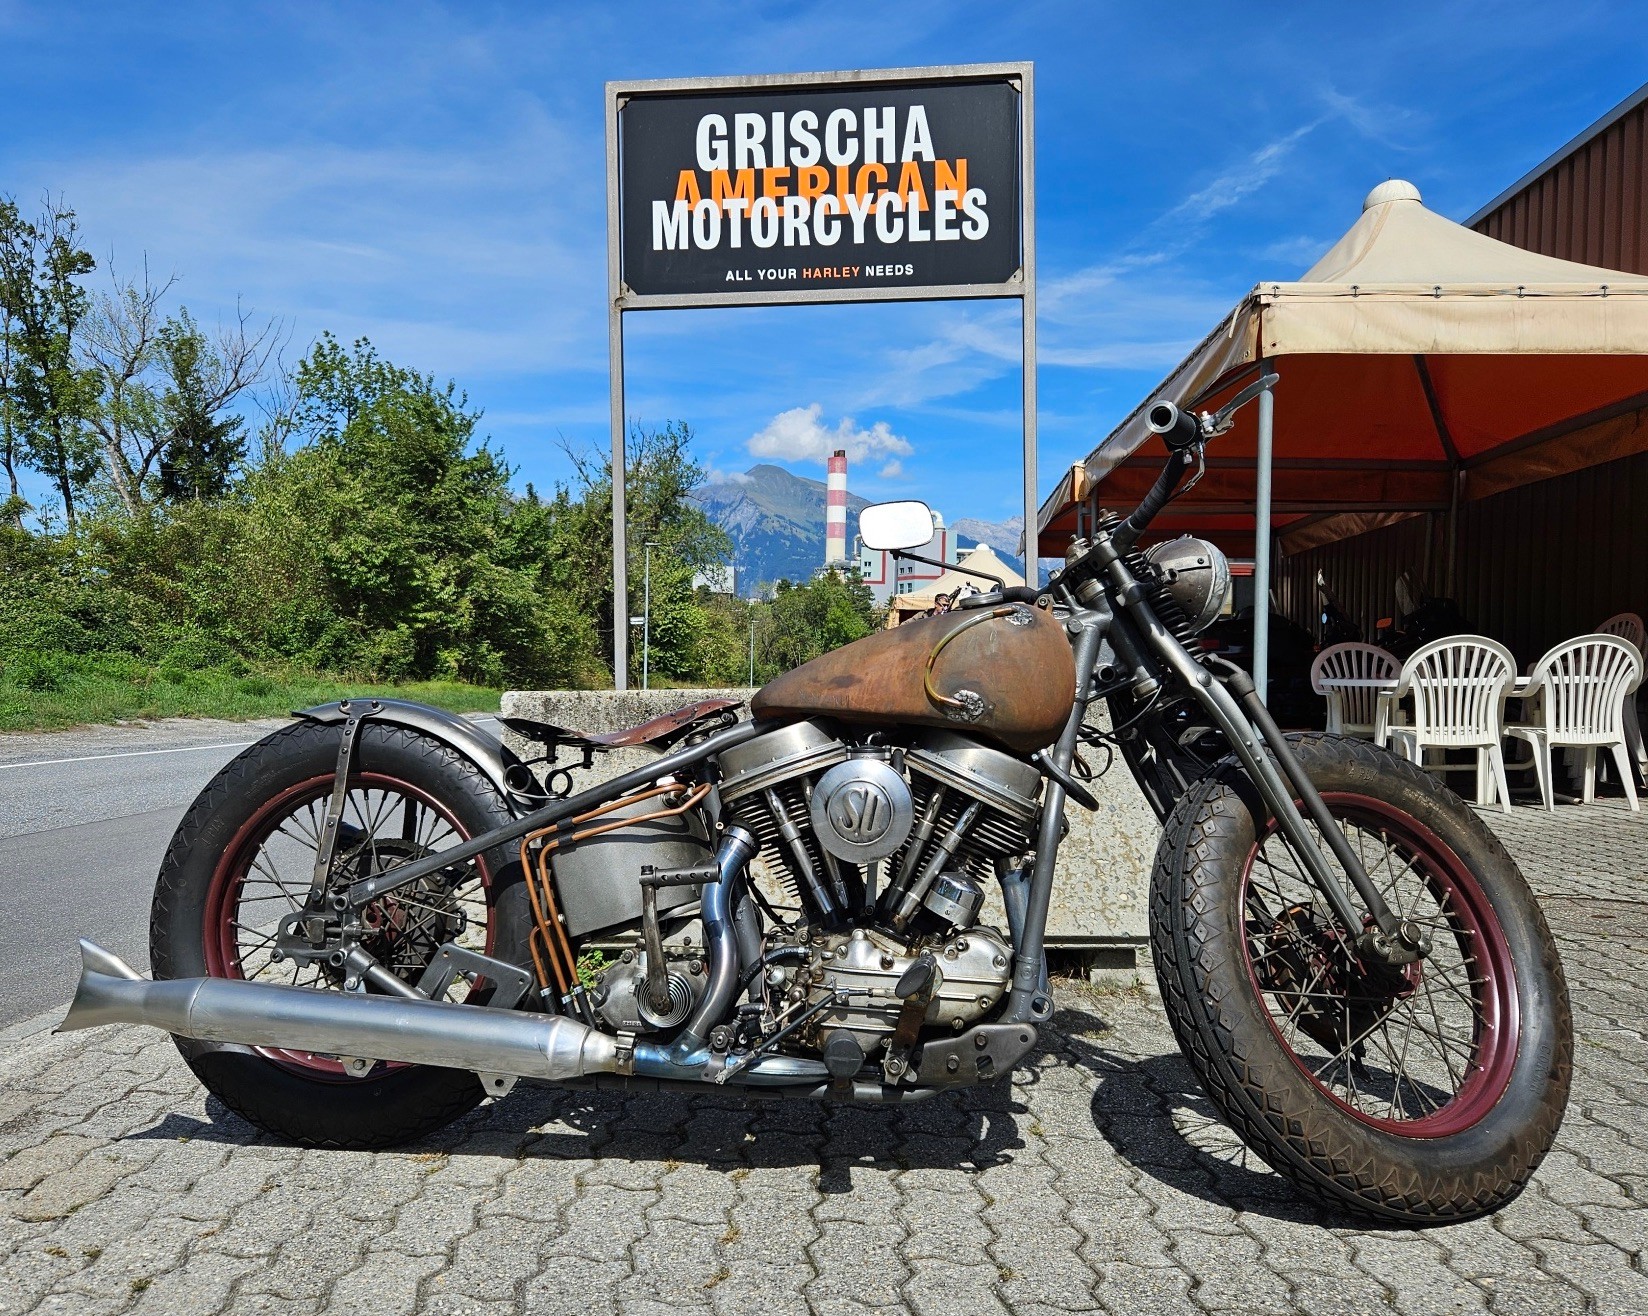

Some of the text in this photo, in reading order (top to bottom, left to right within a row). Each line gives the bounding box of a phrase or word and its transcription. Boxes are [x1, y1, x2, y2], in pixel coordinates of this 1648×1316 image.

[695, 104, 936, 172] GRISCHA
[651, 187, 990, 251] MOTORCYCLES
[674, 158, 969, 219] AMERICAN
[725, 264, 914, 281] ALL YOUR HARLEY NEEDS
